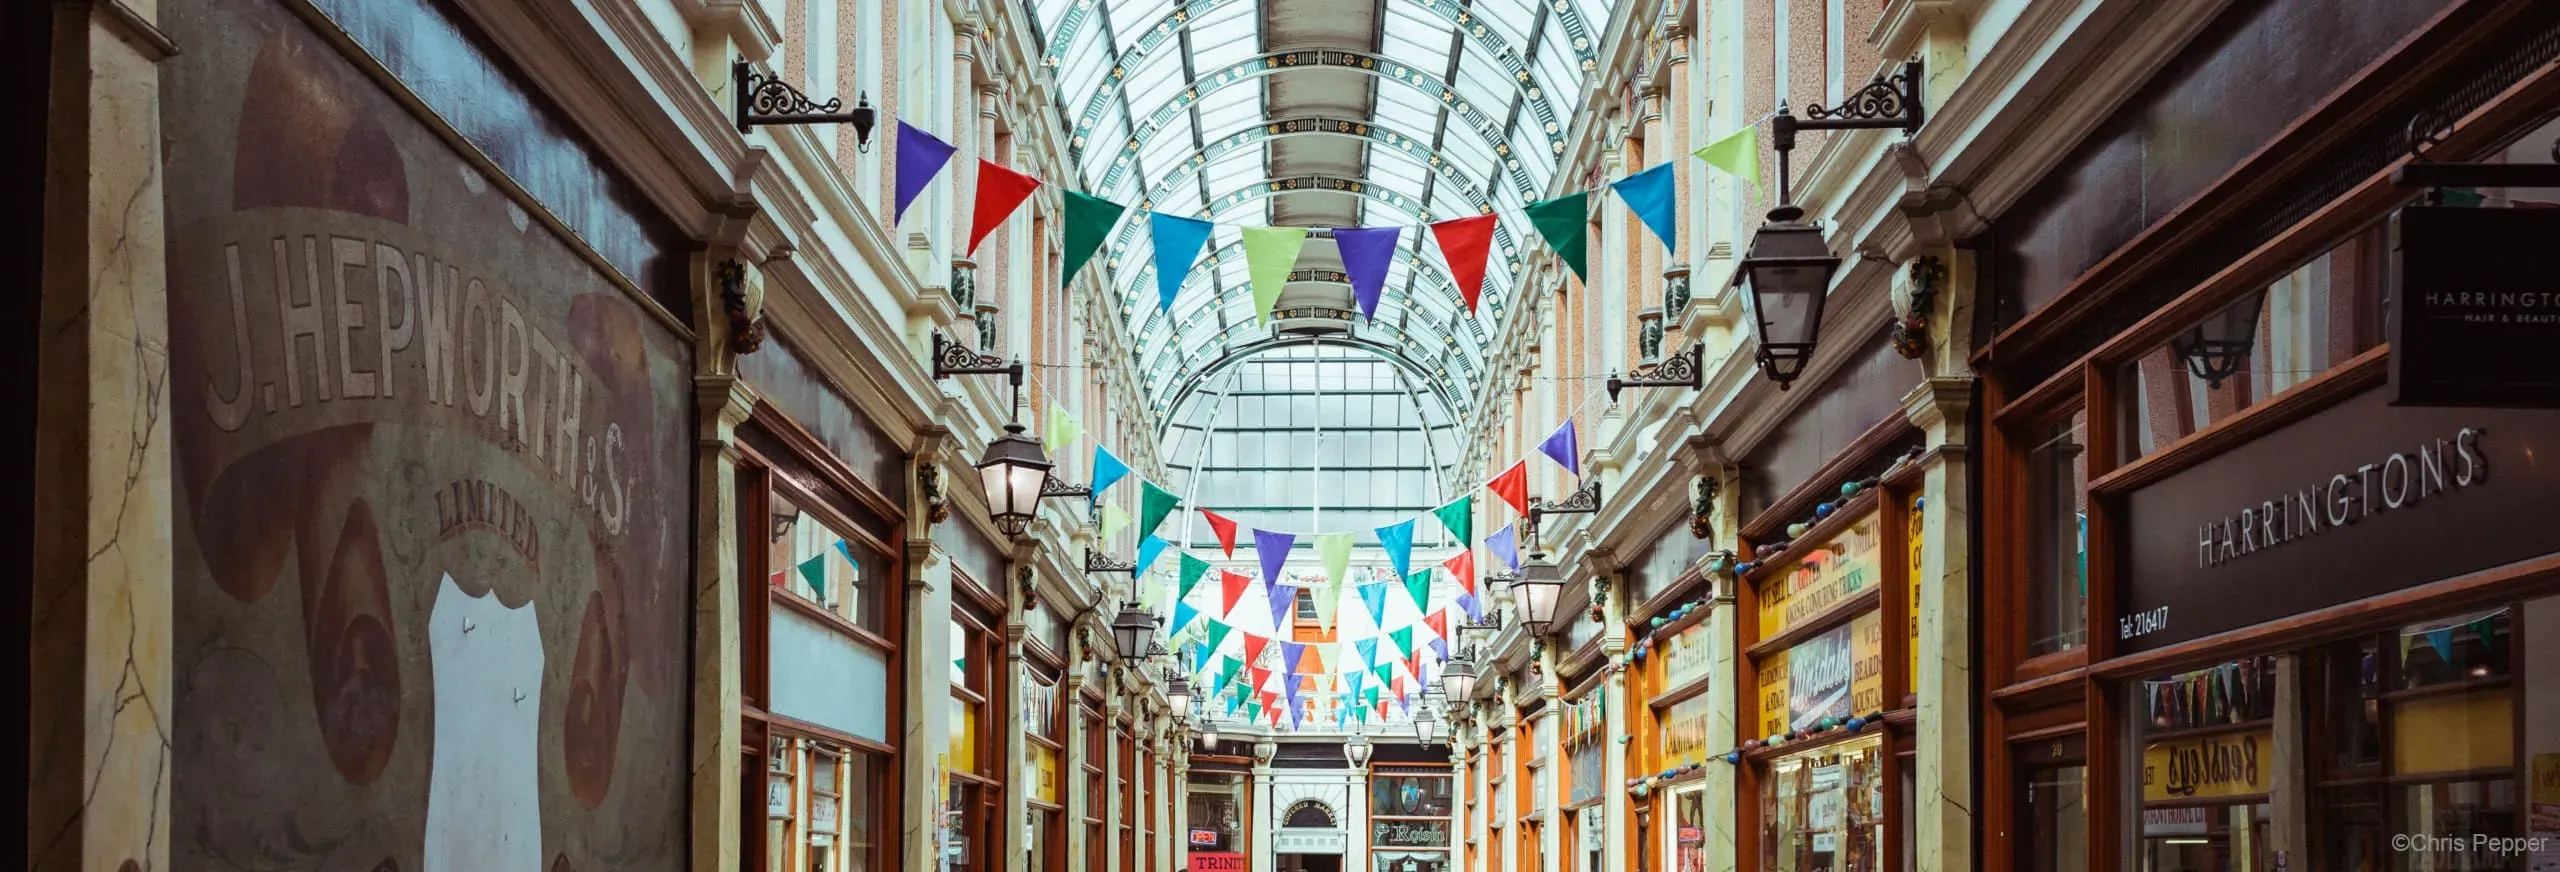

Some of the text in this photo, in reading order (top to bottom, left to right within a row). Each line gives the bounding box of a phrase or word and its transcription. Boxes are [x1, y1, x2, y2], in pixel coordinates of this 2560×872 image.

[433, 479, 541, 572] LIMITED
[2199, 427, 2474, 569] HARRINGTONS
[2119, 605, 2169, 640] Tel: 216417
[1283, 801, 1338, 826] COVERED MARKET
